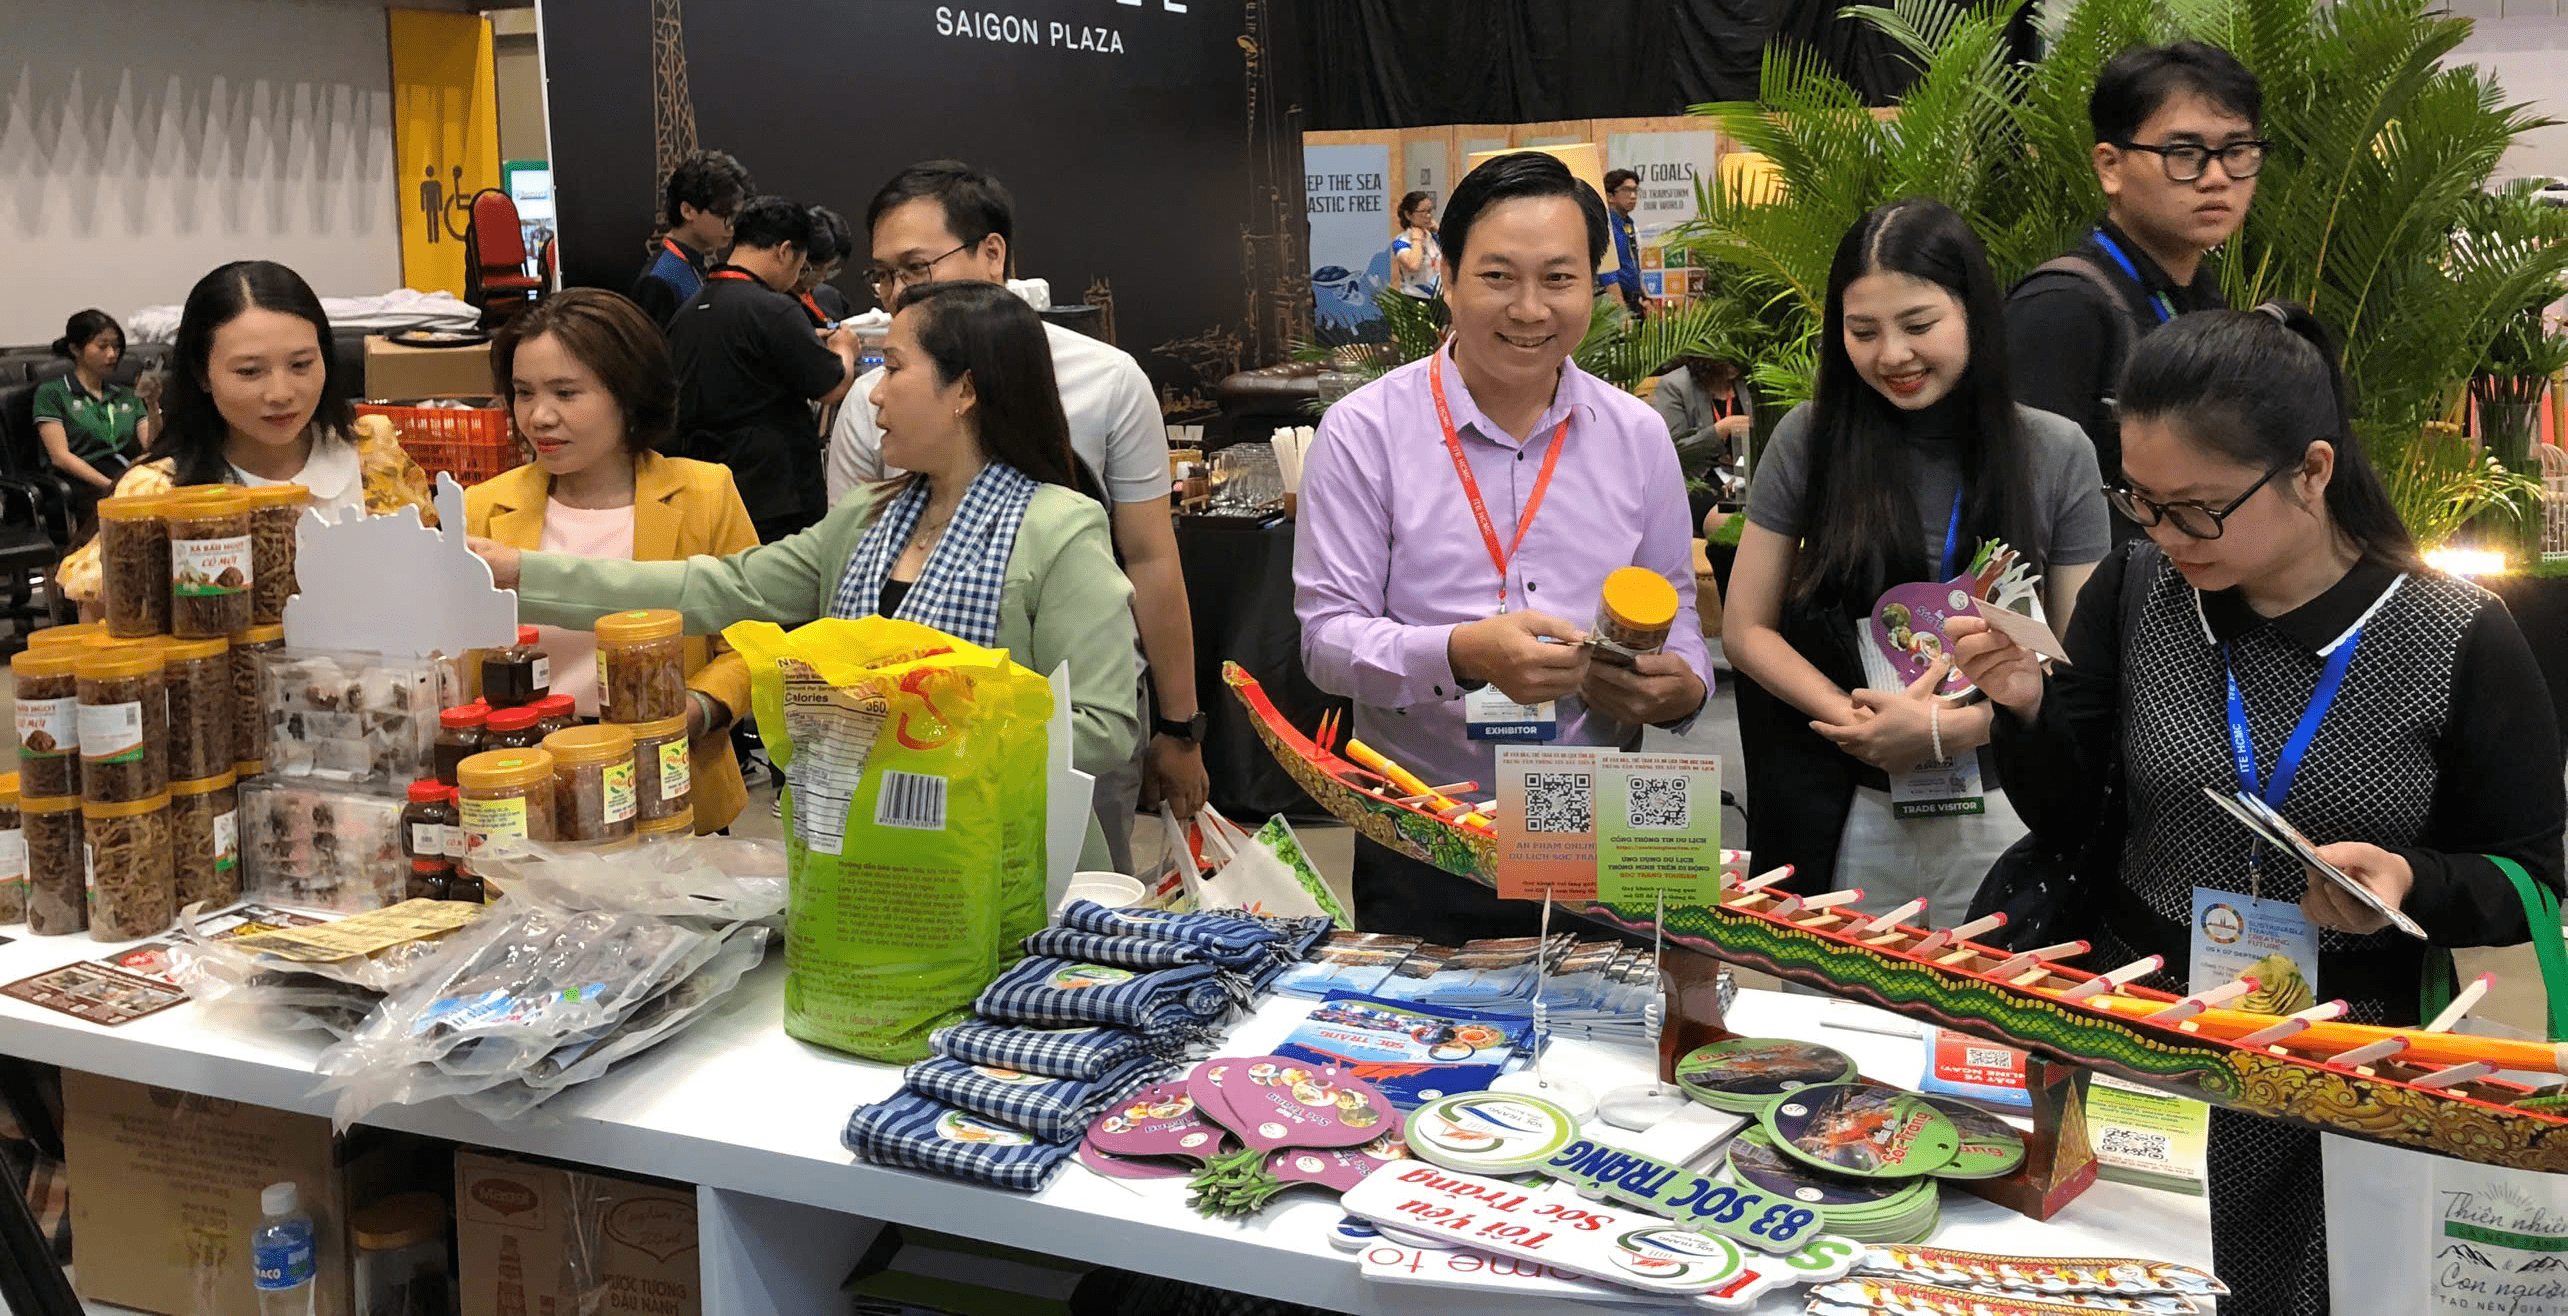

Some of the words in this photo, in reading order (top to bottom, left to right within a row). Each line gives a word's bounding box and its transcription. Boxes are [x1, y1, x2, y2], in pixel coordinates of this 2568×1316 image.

[935, 6, 1039, 45] SAIGON
[1049, 21, 1125, 54] PLAZA
[1328, 174, 1353, 191] THE
[1356, 173, 1382, 191] SEA
[1650, 162, 1693, 181] GOALS
[1307, 196, 1345, 213] ASTIC
[1349, 195, 1382, 212] FREE
[1649, 187, 1689, 198] TRANSFORM
[784, 692, 829, 703] Calories
[1485, 726, 1537, 735] EXHIBITOR
[2232, 724, 2247, 753] HCMC
[1902, 804, 1936, 814] TRADE
[1937, 801, 1977, 811] VISITOR
[2247, 939, 2281, 950] FUTURE
[2248, 933, 2290, 946] CREATING
[1986, 1070, 2025, 1079] NLINE
[1305, 1111, 1332, 1127] Sóc
[1548, 1141, 1679, 1200] TRĂNG
[1396, 1169, 1529, 1214] Trăng
[1669, 1175, 1763, 1224] SÓC
[1395, 1200, 1477, 1232] yêu
[1533, 1203, 1617, 1232] Sóc
[2441, 1190, 2504, 1227] Thiên
[1475, 1221, 1554, 1250] Tôi
[1750, 1206, 1815, 1242] 83
[1368, 1247, 1422, 1274] to
[2441, 1262, 2487, 1293] Con
